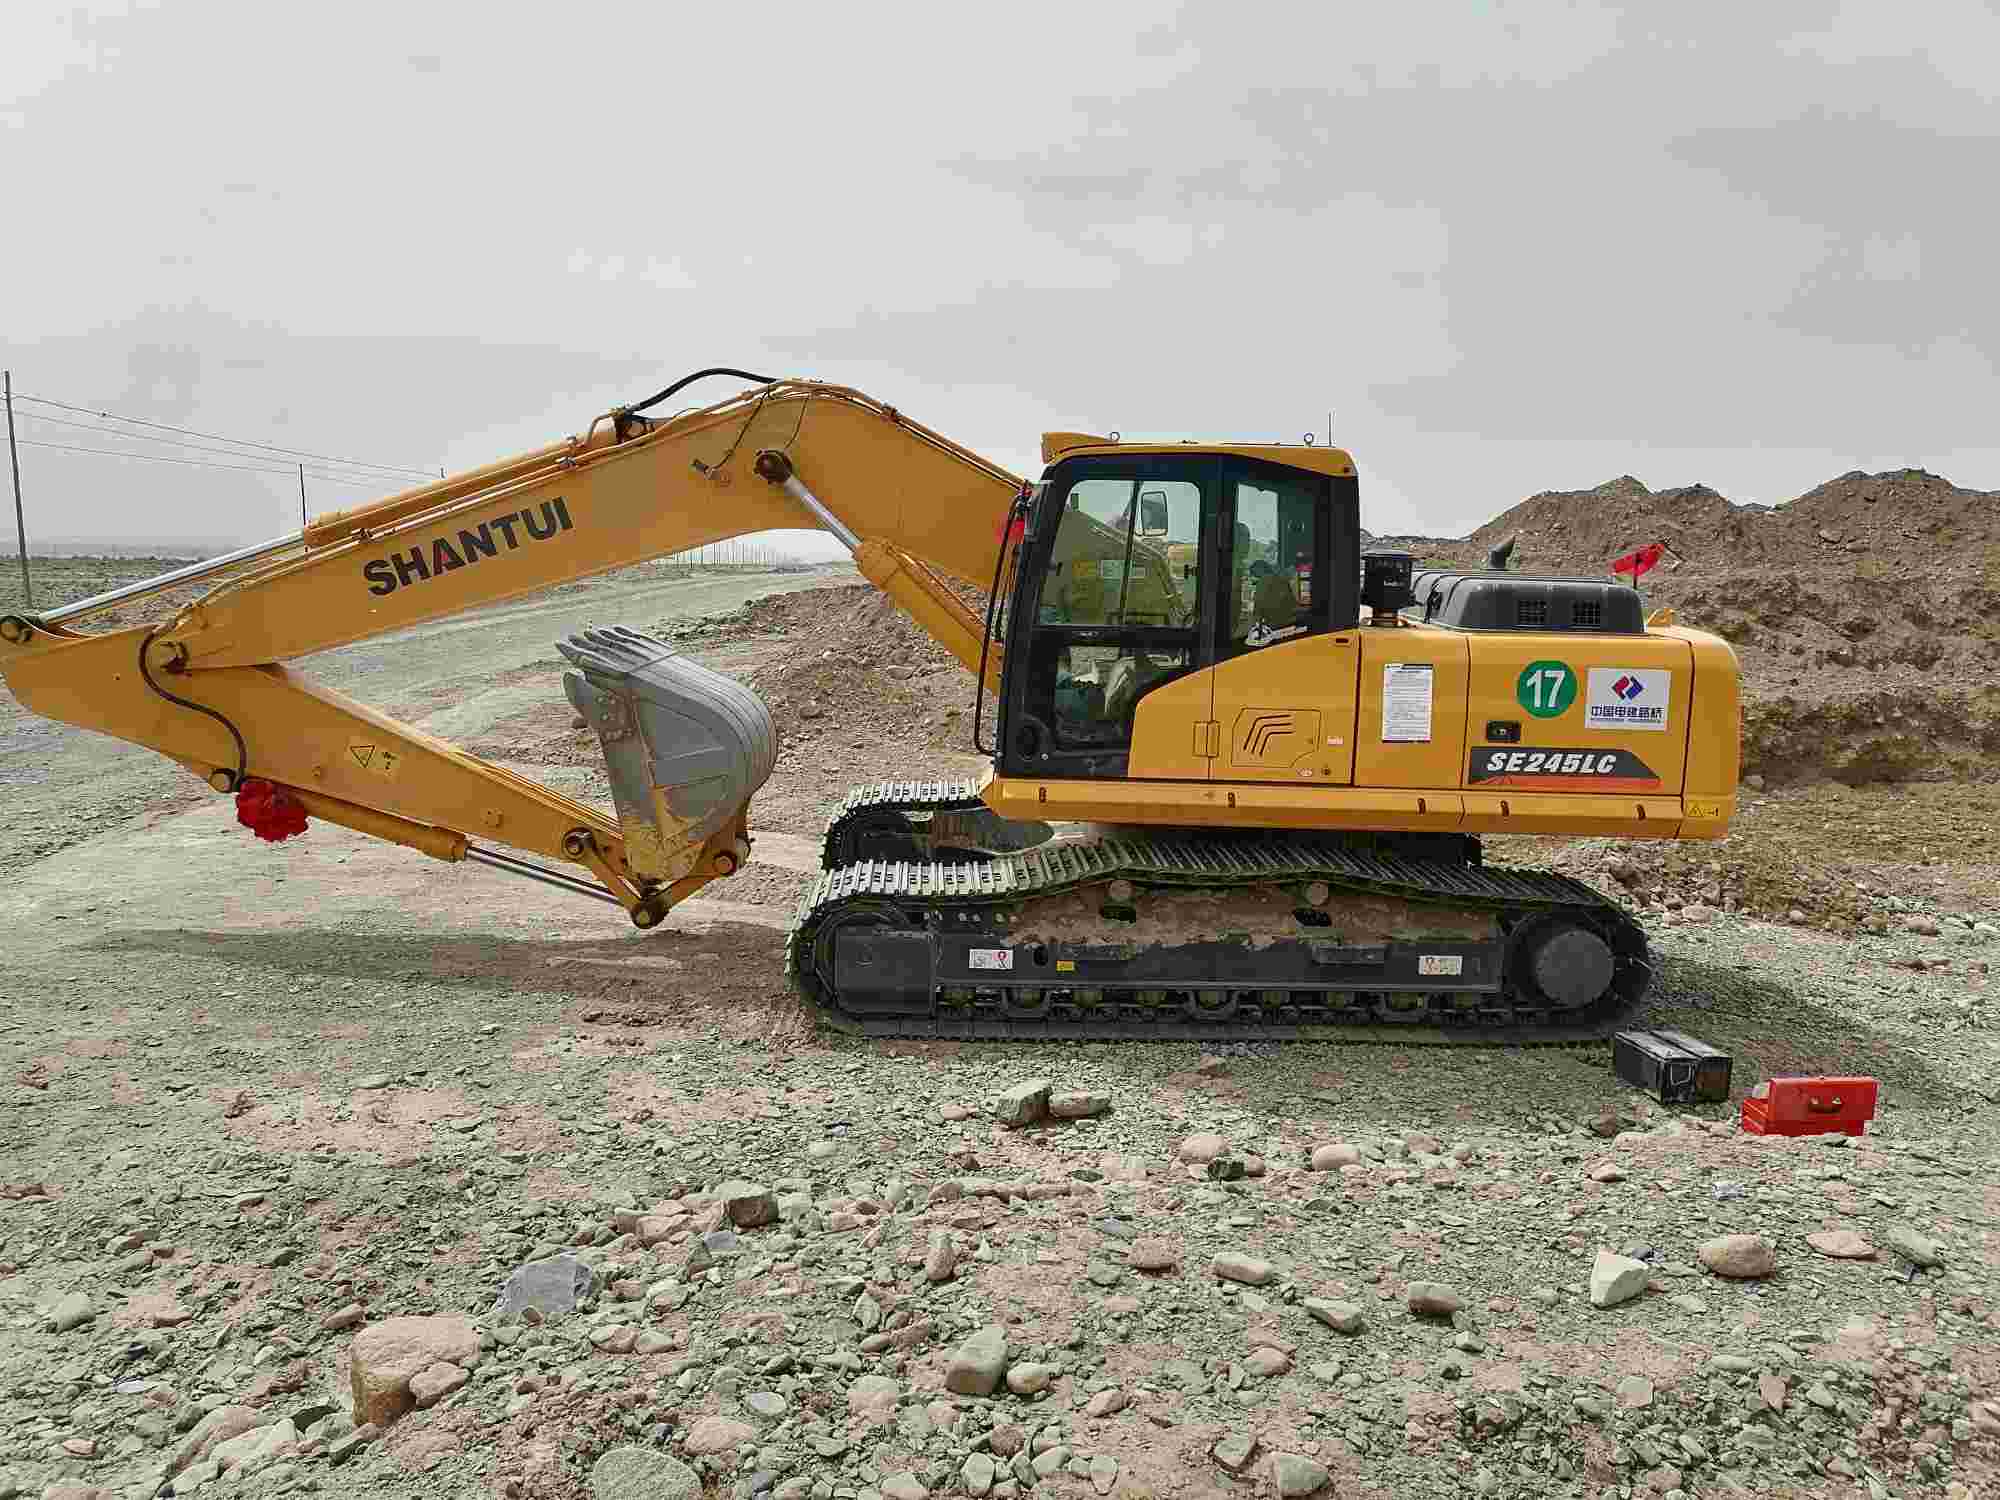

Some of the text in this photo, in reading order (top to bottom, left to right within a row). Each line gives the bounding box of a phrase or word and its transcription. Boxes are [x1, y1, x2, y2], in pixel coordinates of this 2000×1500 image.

[363, 496, 574, 596] SHANTUI
[1526, 669, 1566, 708] 17
[1487, 752, 1617, 774] SE245LC
